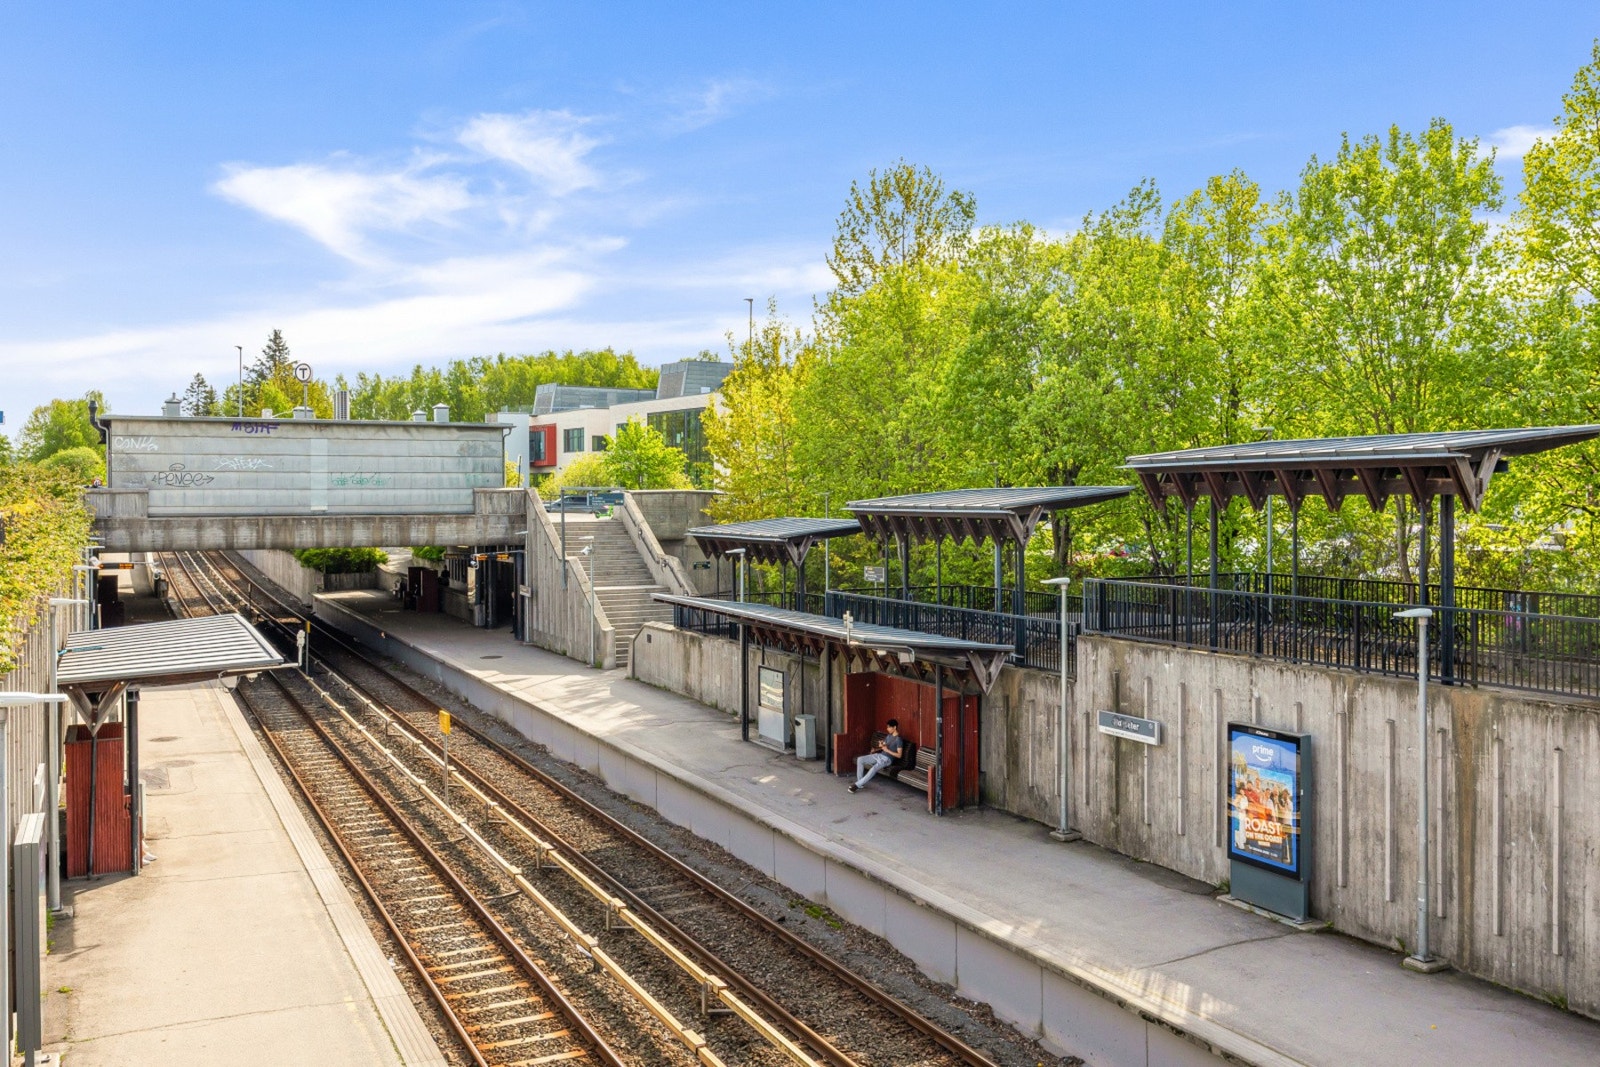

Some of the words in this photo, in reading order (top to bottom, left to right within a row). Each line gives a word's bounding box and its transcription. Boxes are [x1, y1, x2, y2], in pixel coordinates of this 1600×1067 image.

[299, 368, 307, 379] T
[1252, 745, 1274, 756] prime
[1245, 817, 1281, 836] ROAST
